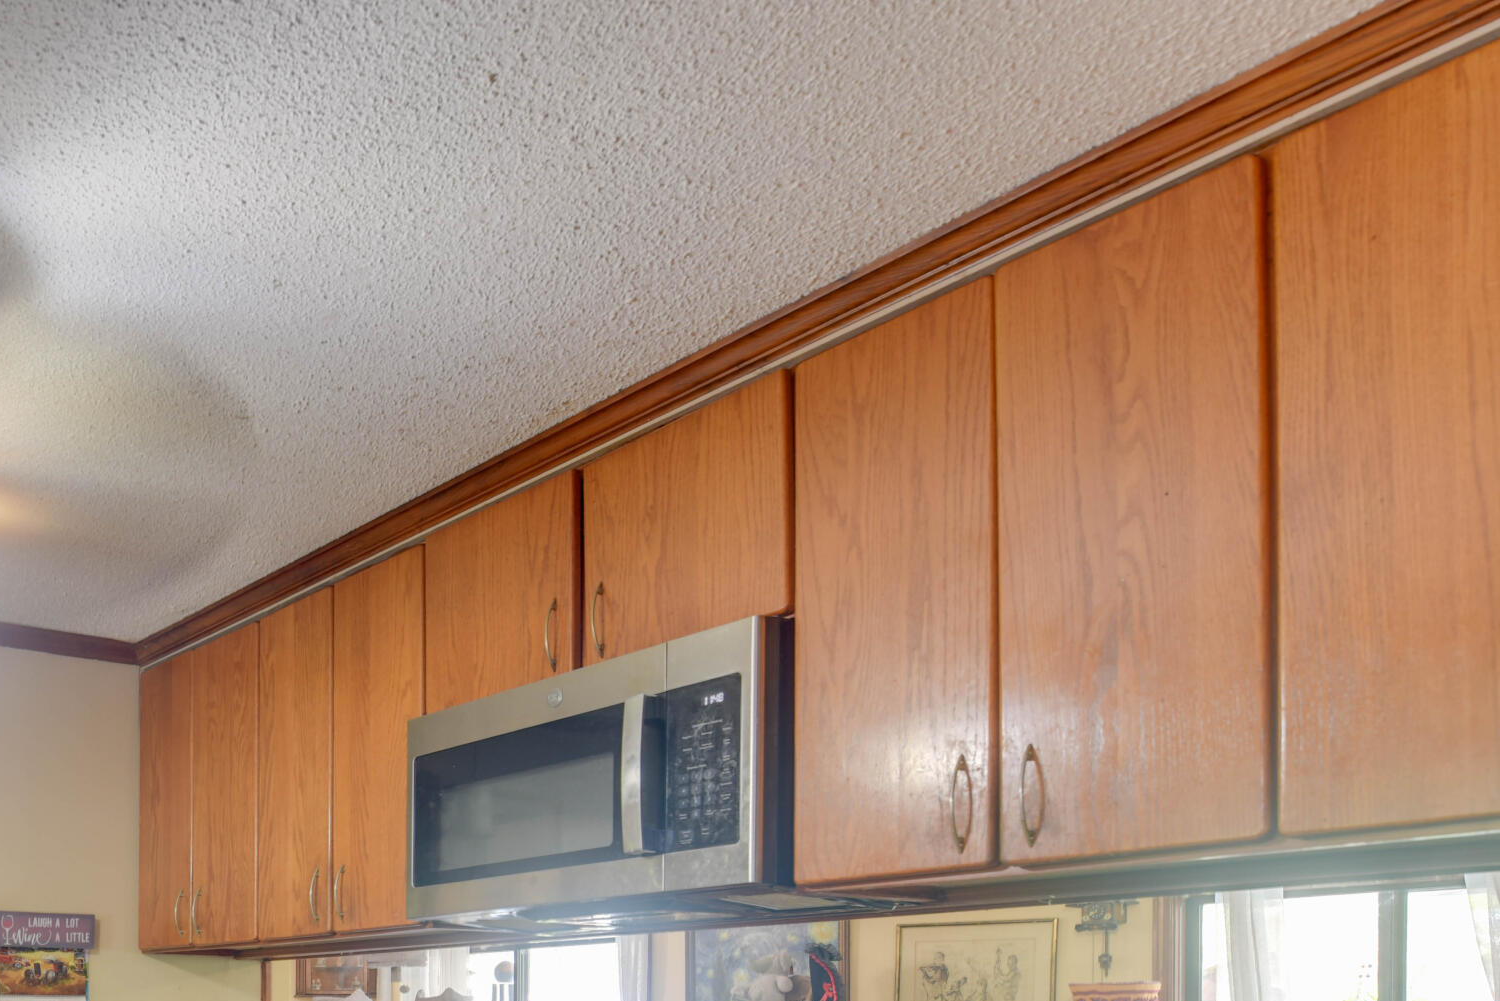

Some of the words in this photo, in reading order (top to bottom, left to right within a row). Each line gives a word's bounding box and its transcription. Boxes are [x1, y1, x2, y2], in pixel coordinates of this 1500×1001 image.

[28, 917, 52, 928] LAUGH
[55, 918, 60, 928] A
[65, 918, 80, 928] LOT
[11, 927, 52, 945] Wine
[55, 932, 60, 942] A
[65, 932, 90, 943] LITTLE
